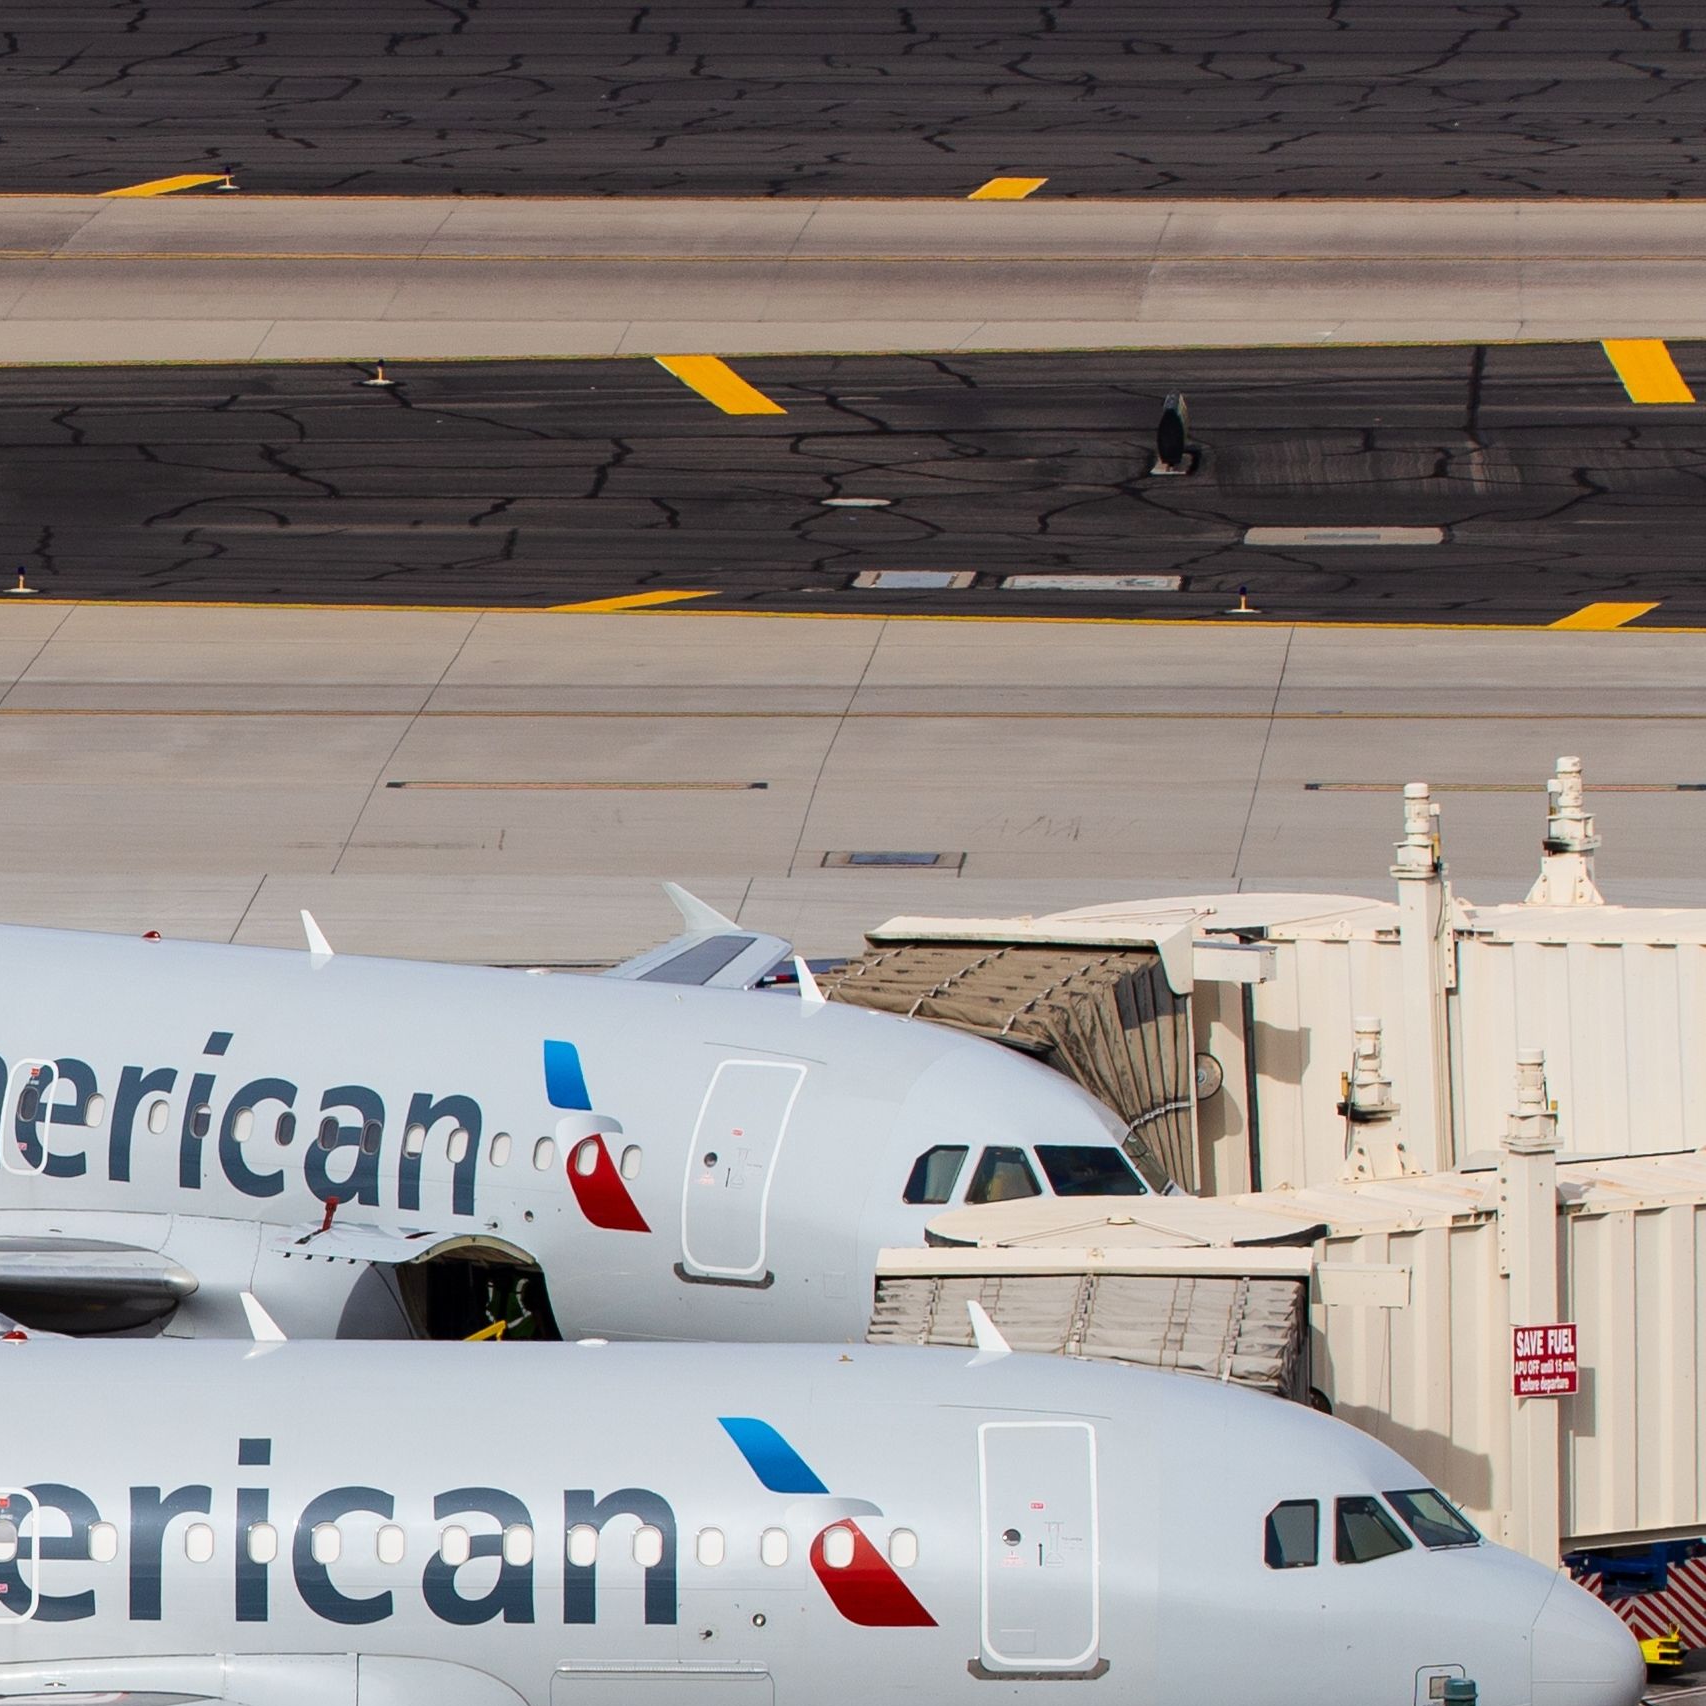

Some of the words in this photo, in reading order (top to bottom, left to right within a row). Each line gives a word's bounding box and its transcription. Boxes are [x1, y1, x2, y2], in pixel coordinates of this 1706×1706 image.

[1516, 1329, 1545, 1357] SAVE
[1547, 1327, 1575, 1355] FUEL
[1528, 1359, 1540, 1375] OFF
[1519, 1377, 1539, 1392] before
[1540, 1375, 1570, 1394] departure
